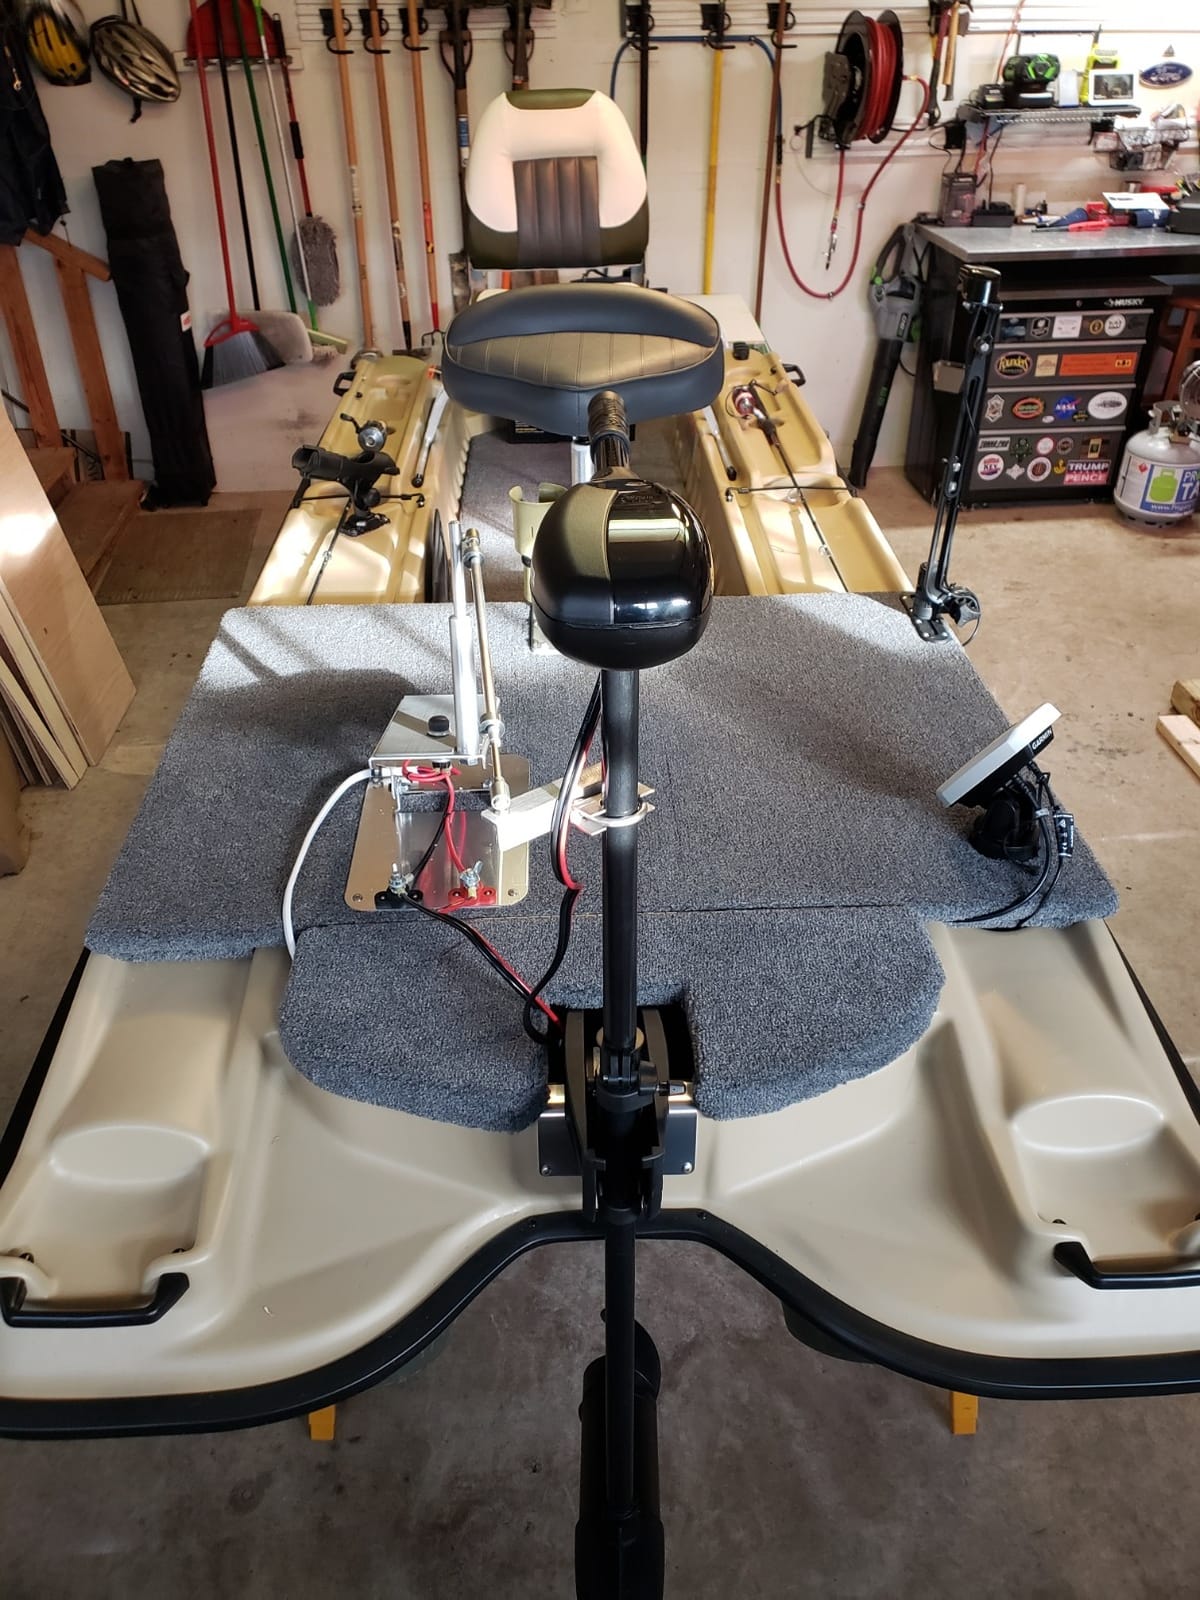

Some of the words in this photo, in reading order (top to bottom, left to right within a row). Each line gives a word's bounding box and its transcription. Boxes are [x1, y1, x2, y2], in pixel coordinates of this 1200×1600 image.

[1114, 298, 1144, 307] HUSKY
[1056, 403, 1075, 412] NASA
[1069, 462, 1109, 471] TRUMP
[1065, 473, 1105, 482] PENCE
[1031, 728, 1052, 750] GARMIN
